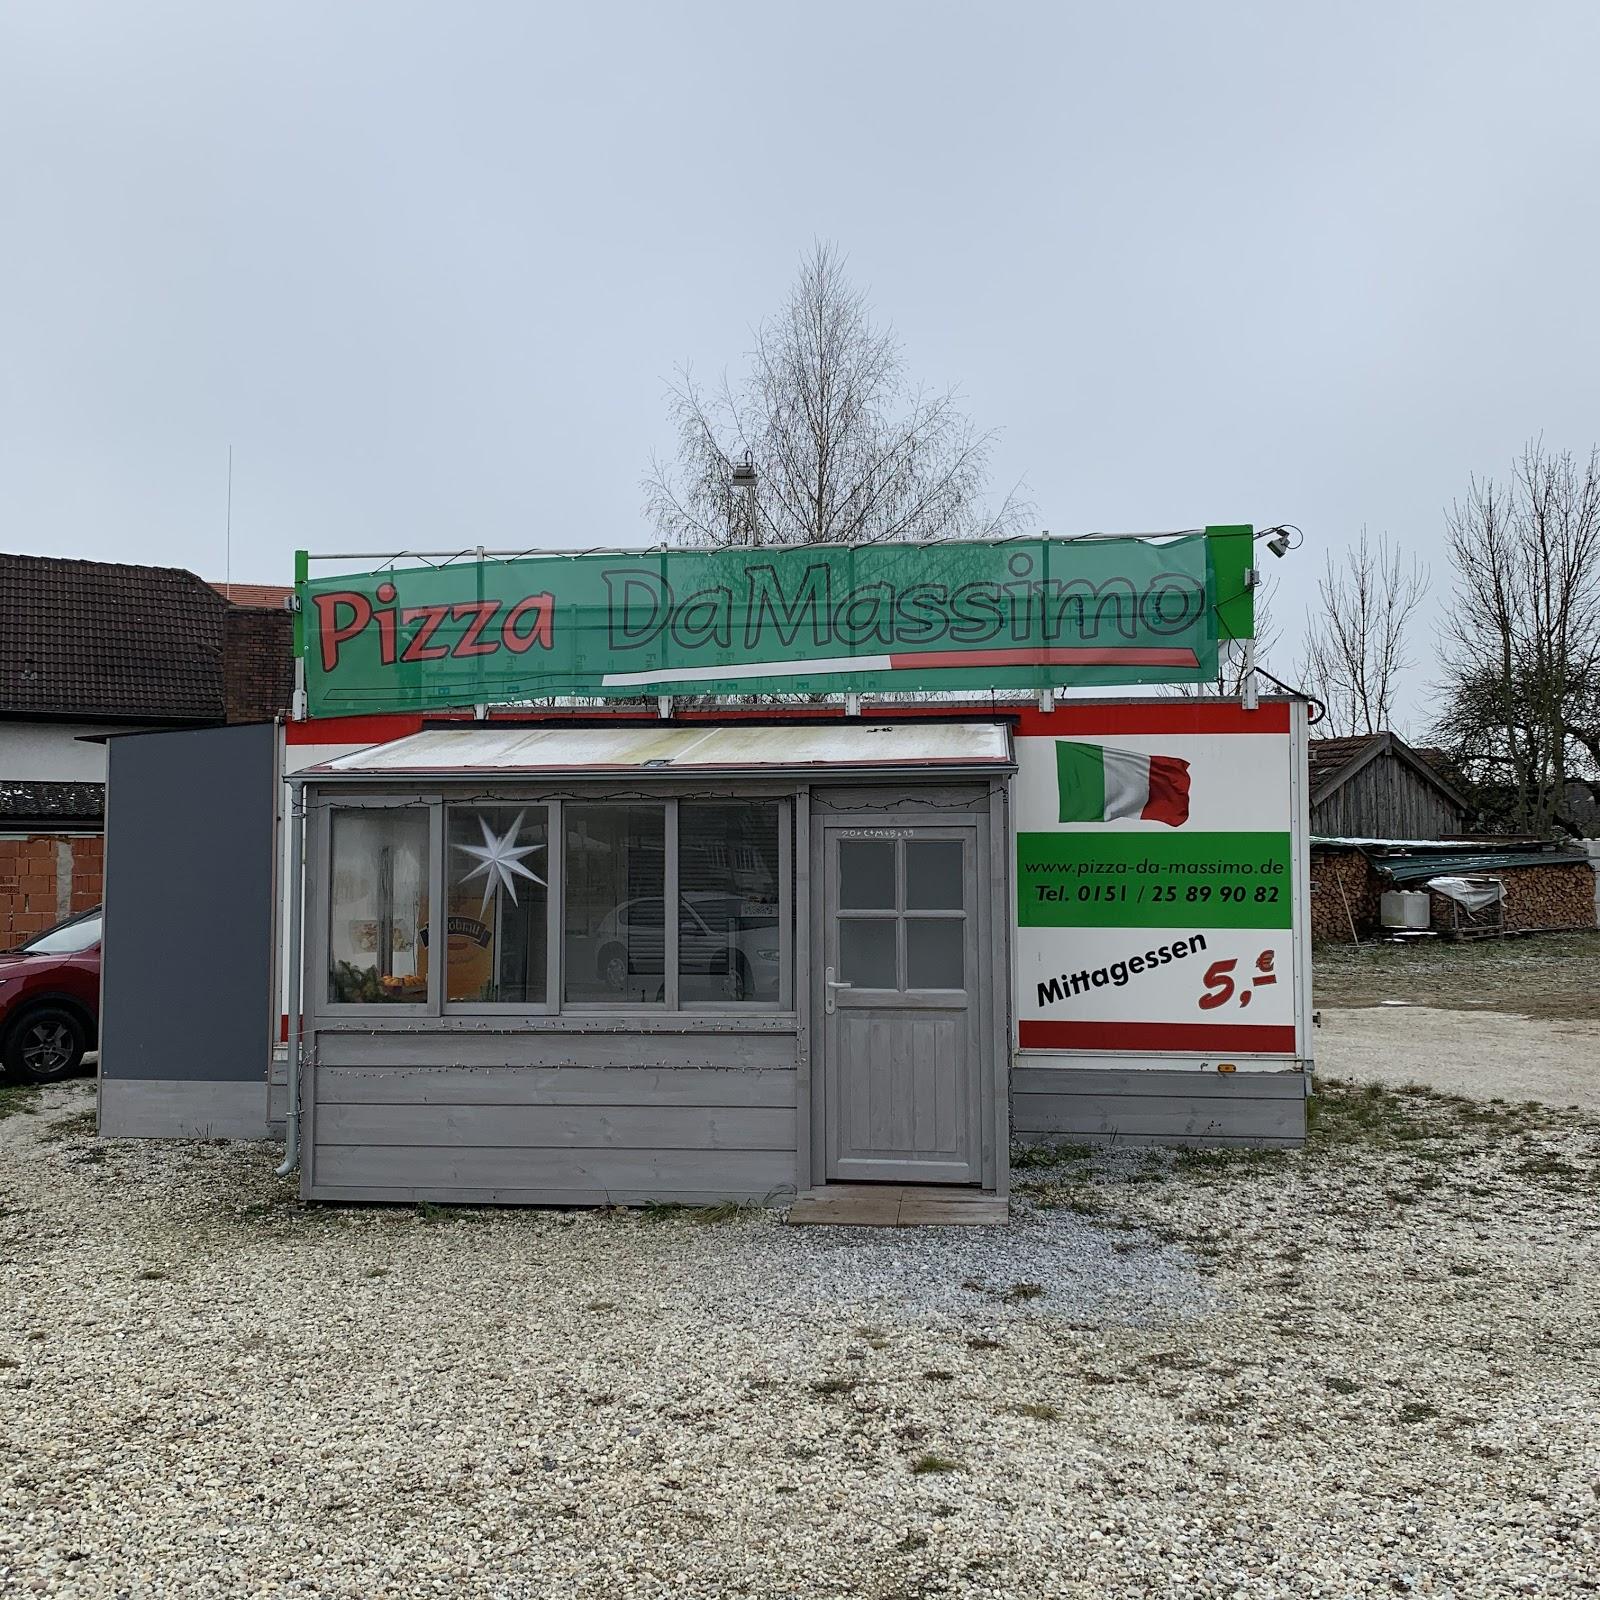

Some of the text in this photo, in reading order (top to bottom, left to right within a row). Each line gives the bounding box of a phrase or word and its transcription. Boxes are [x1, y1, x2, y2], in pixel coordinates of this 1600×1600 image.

[311, 582, 556, 673] Pizza
[1024, 858, 1284, 878] www.pizza-da-massimo.de
[1035, 885, 1070, 902] Tel.
[1077, 885, 1127, 902] 0151
[1151, 886, 1177, 902] 25
[1185, 886, 1212, 903] 89
[1219, 886, 1247, 903] 90
[1253, 886, 1279, 903] 82
[1036, 933, 1208, 1008] Mittagessen
